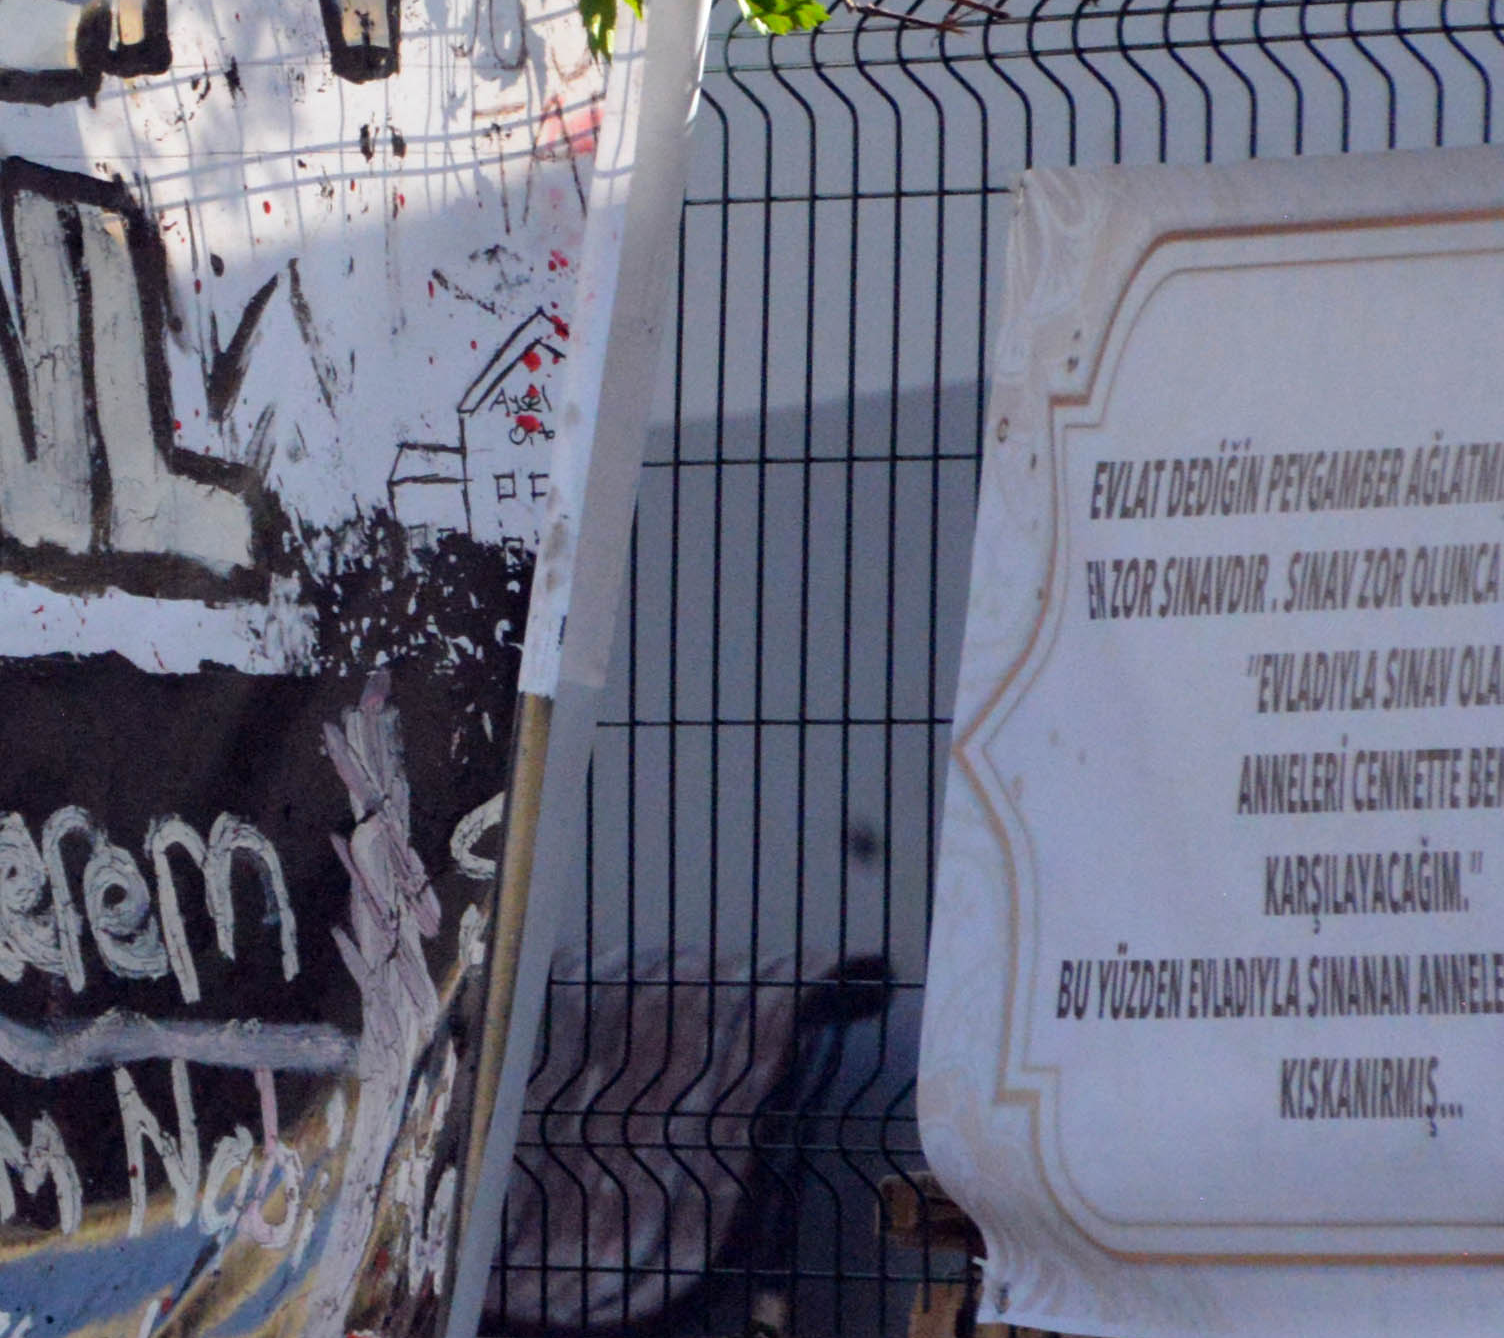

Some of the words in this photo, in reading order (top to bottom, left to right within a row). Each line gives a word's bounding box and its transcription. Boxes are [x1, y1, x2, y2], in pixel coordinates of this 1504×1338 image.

[1090, 459, 1167, 520] EVLAT
[1166, 437, 1265, 518] DEDİĞİN
[1265, 447, 1405, 513] PEYGAMBER
[1087, 559, 1106, 620] EN
[1110, 559, 1157, 619] ZOR
[1158, 554, 1270, 618] SINAVDIR
[1284, 550, 1359, 613] SINAV
[1357, 548, 1406, 608] ZOR
[1411, 542, 1502, 607] OLUNCA
[1382, 647, 1455, 709] SINAV
[1237, 733, 1348, 815] ANNELERİ
[1352, 747, 1464, 811] CENNETTE
[1056, 959, 1090, 1021] BU
[1097, 942, 1184, 1020] YÜZDEN
[1188, 957, 1301, 1019] EVLADIYLA
[1306, 954, 1411, 1018] SINANAN
